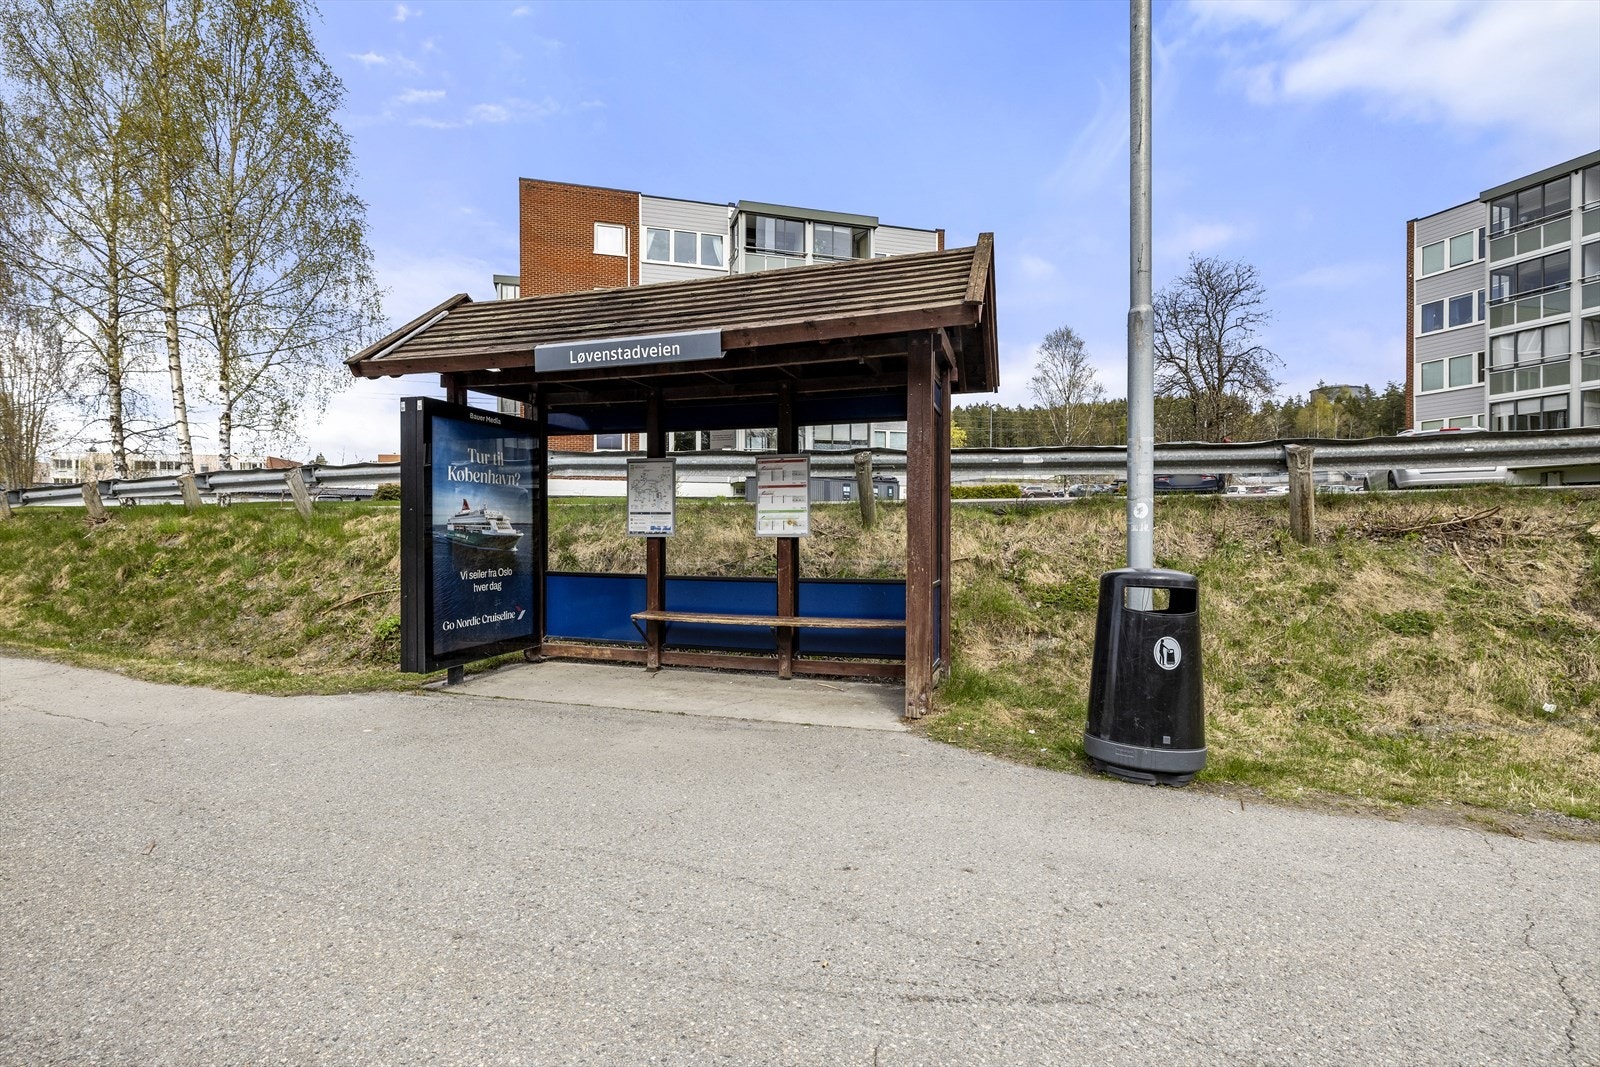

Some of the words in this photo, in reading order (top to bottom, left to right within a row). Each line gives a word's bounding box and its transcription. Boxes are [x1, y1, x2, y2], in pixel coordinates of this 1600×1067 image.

[569, 343, 680, 364] Løvenstadveien
[469, 412, 486, 422] Bauer
[486, 416, 502, 425] Media
[467, 447, 491, 465] Tur
[493, 451, 504, 466] til
[447, 465, 521, 486] København?
[460, 570, 468, 580] Vi
[469, 569, 488, 580] seiler
[488, 567, 497, 577] fra
[498, 567, 513, 577] Oslo
[473, 583, 488, 592] hver
[489, 581, 502, 592] dag
[442, 620, 455, 631] Go
[456, 615, 481, 629] Nordic
[481, 611, 516, 624] Cruiseline
